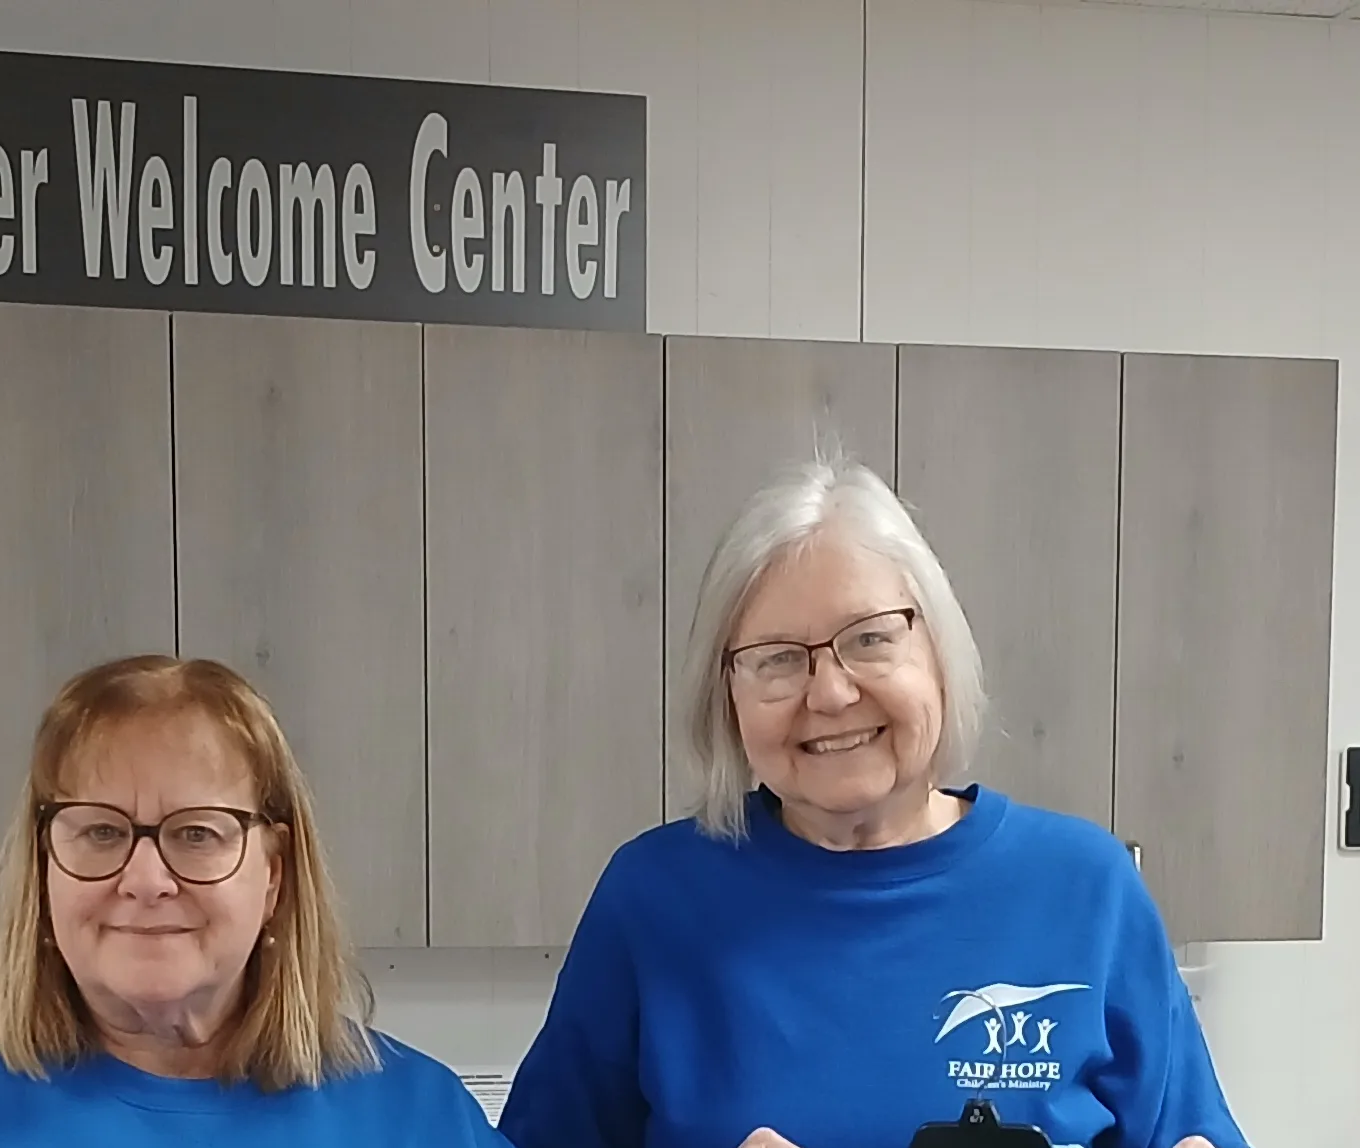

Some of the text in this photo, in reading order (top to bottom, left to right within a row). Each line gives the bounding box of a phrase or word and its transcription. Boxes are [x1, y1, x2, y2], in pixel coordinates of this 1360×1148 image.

[71, 96, 376, 289] Welcome
[410, 112, 630, 300] Center
[1000, 1062, 1060, 1080] HOPE
[1008, 1079, 1051, 1091] Ministry
